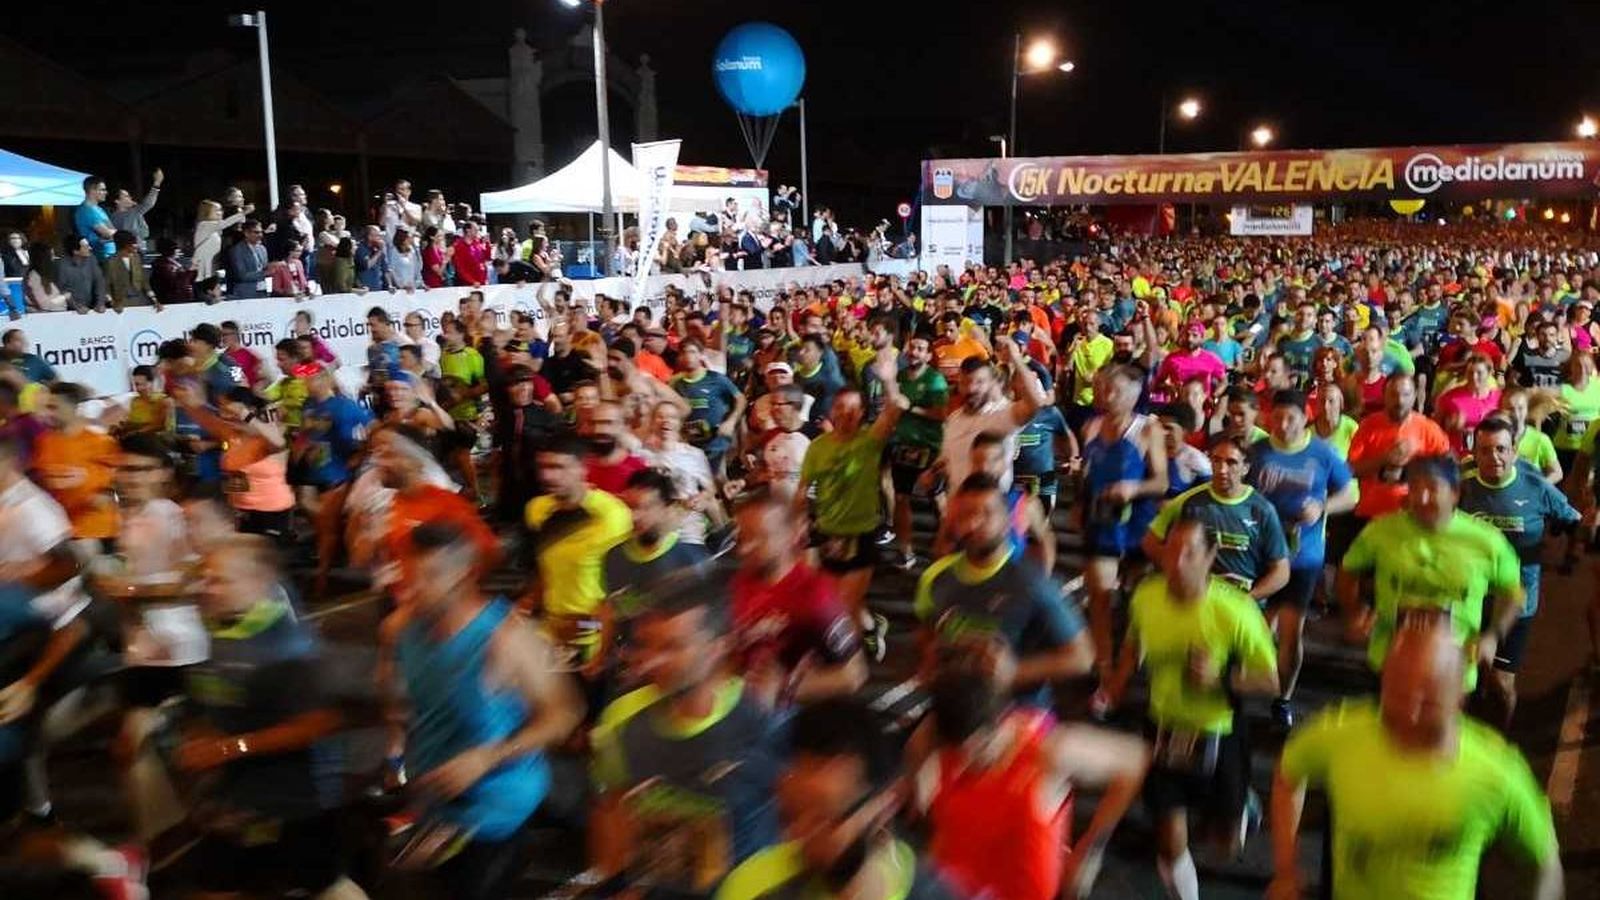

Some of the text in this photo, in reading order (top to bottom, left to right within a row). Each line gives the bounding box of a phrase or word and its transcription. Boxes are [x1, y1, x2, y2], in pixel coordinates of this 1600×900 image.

[1018, 159, 1395, 197] 15K Nocturna VALENCIA
[1406, 154, 1585, 193] mediolanum
[80, 336, 116, 345] BANCO
